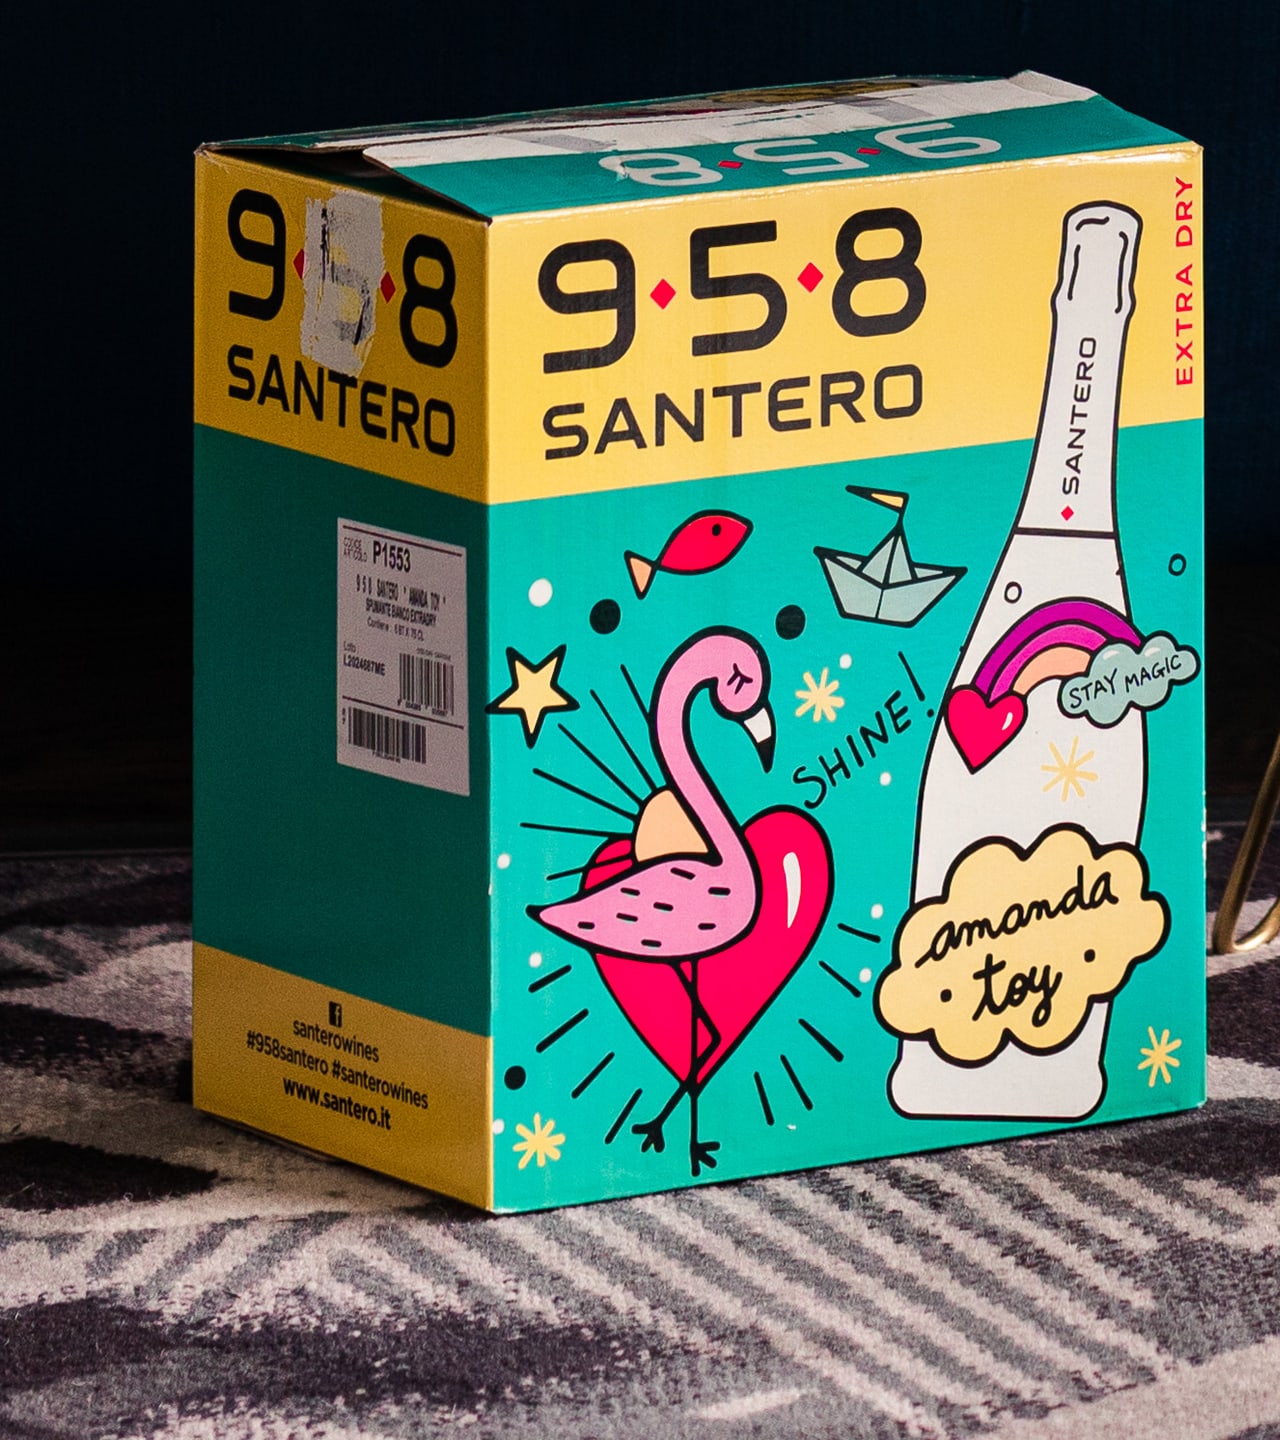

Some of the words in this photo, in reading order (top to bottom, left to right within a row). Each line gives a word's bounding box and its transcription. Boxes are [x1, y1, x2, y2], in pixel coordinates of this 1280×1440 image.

[1175, 176, 1193, 248] DRY
[1175, 263, 1193, 386] EXTRA
[227, 343, 456, 458] SANTERO
[542, 363, 923, 461] SANTERO
[1062, 336, 1097, 496] SANTERO
[373, 540, 411, 573] P1553
[1068, 667, 1118, 709] STAY
[1124, 654, 1182, 692] MAGIC
[793, 650, 935, 810] SHINE!
[915, 865, 1119, 968] amanda
[972, 953, 1063, 1028] toy
[246, 1030, 329, 1075] #958santero
[332, 1059, 429, 1110] #santerowines
[293, 1019, 380, 1063] santerowines
[283, 1077, 391, 1130] www.santero.it
